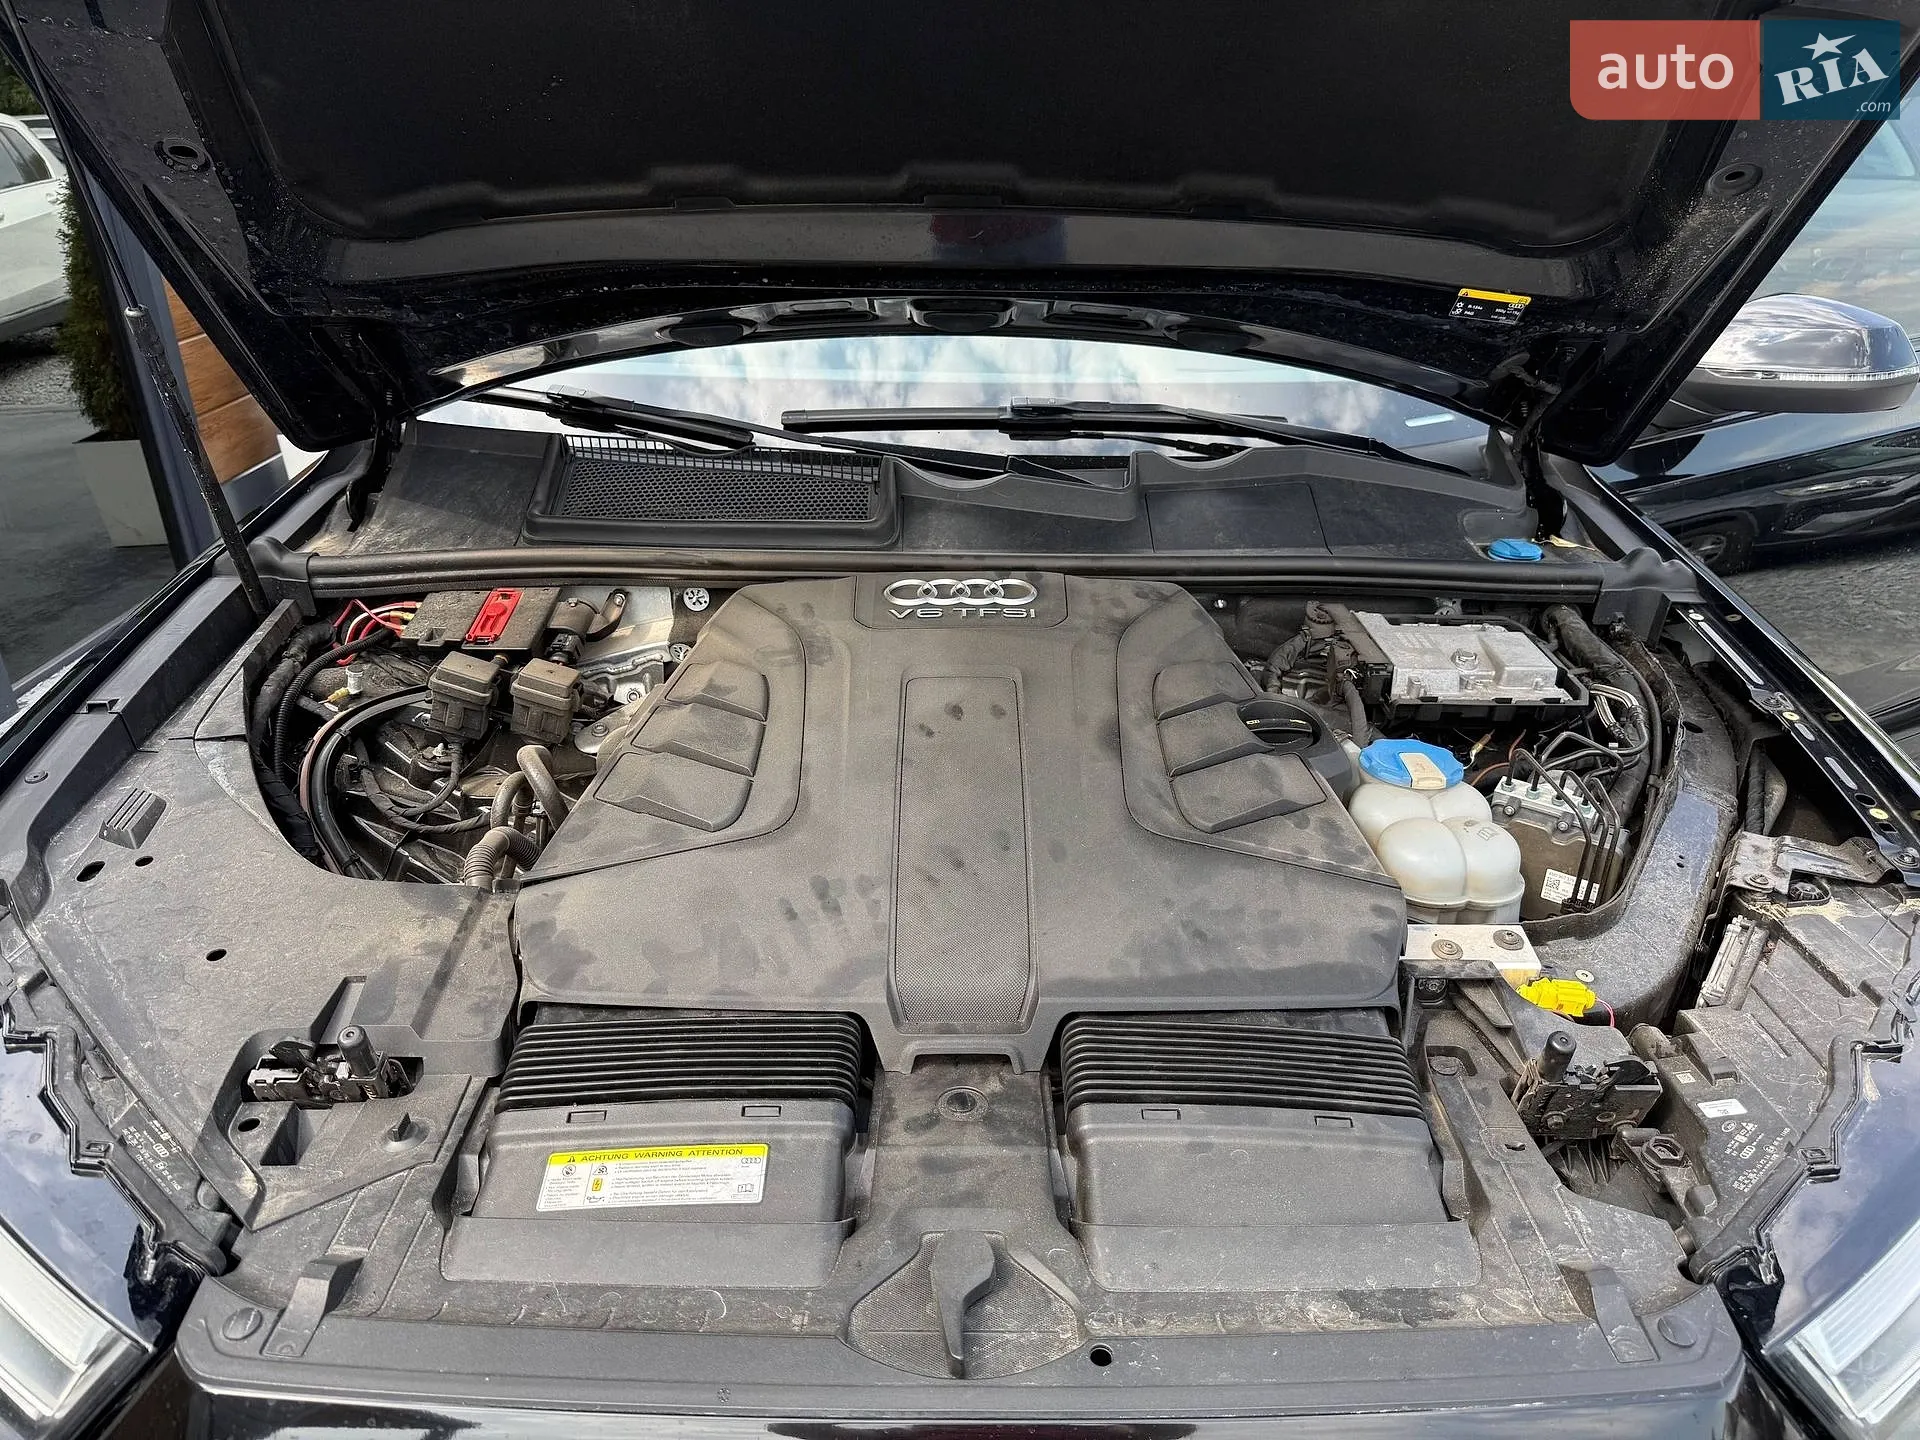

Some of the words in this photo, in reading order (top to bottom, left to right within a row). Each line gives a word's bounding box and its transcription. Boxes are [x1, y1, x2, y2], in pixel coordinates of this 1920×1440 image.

[888, 608, 943, 619] V6
[952, 608, 1036, 618] TFSI
[580, 1153, 629, 1162] ACHTUNG
[634, 1150, 683, 1159] WARNING
[688, 1148, 743, 1157] ATTENTION
